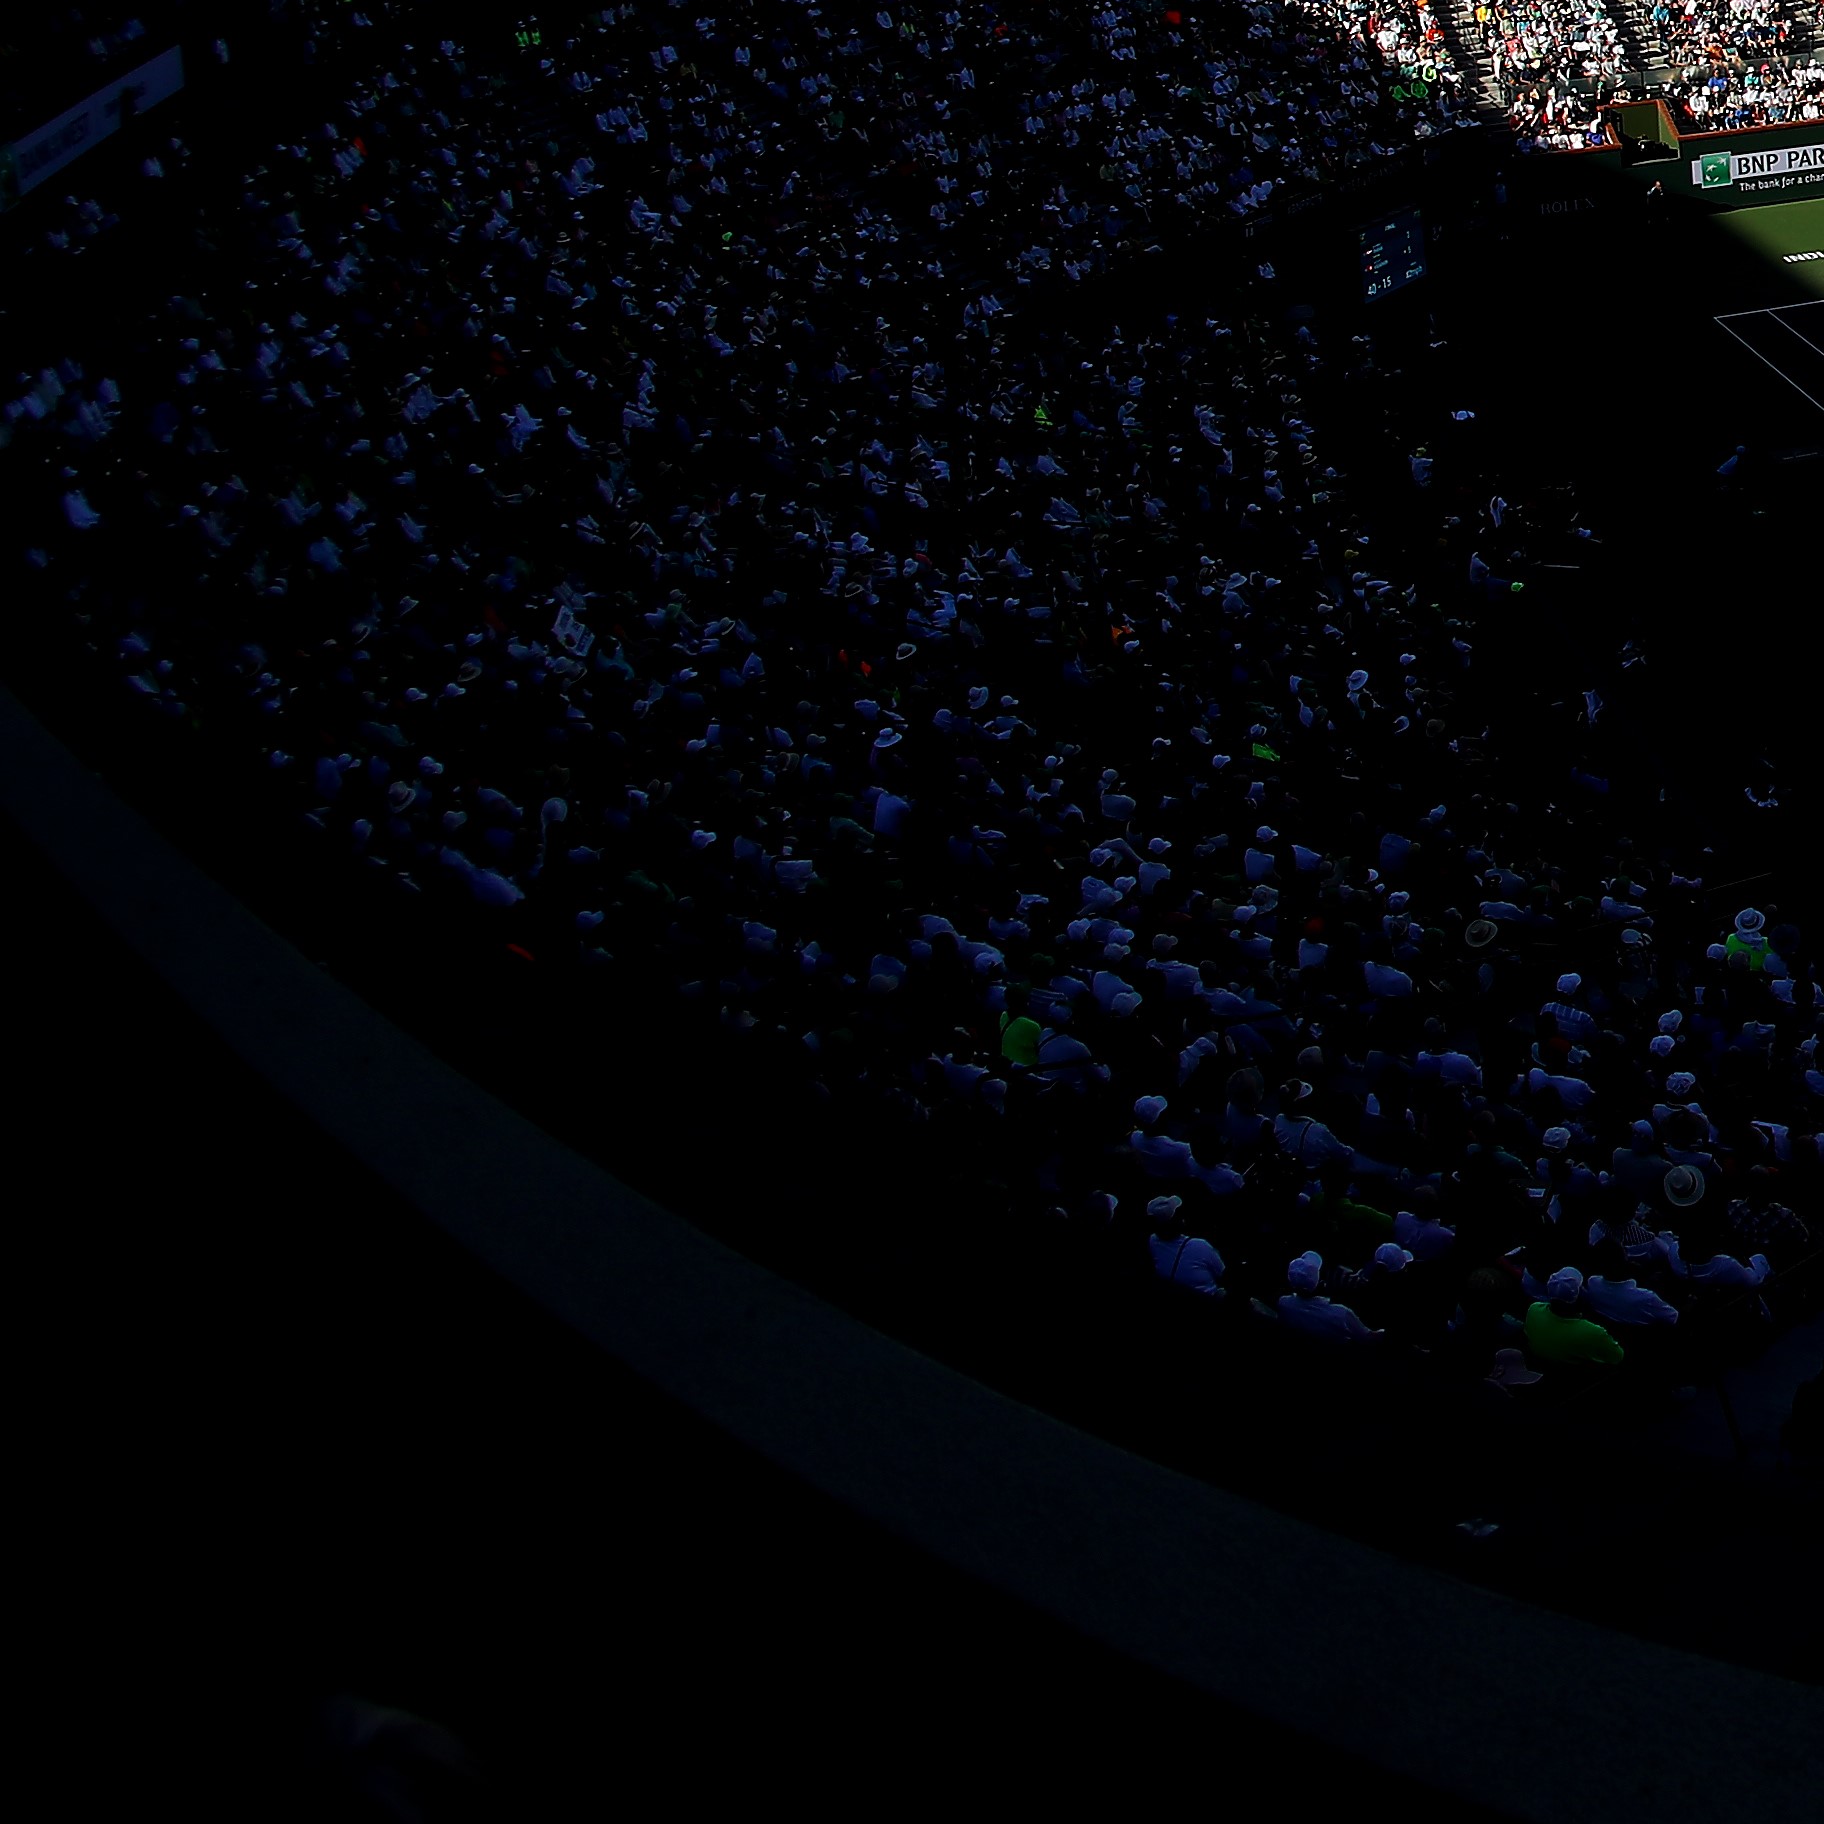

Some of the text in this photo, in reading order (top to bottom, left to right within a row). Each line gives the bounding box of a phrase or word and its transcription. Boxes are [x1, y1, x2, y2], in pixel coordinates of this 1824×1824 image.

[1737, 153, 1779, 176] BNP
[1738, 181, 1756, 192] The
[1757, 177, 1780, 190] bank
[1781, 176, 1796, 189] for
[1796, 176, 1803, 185] a
